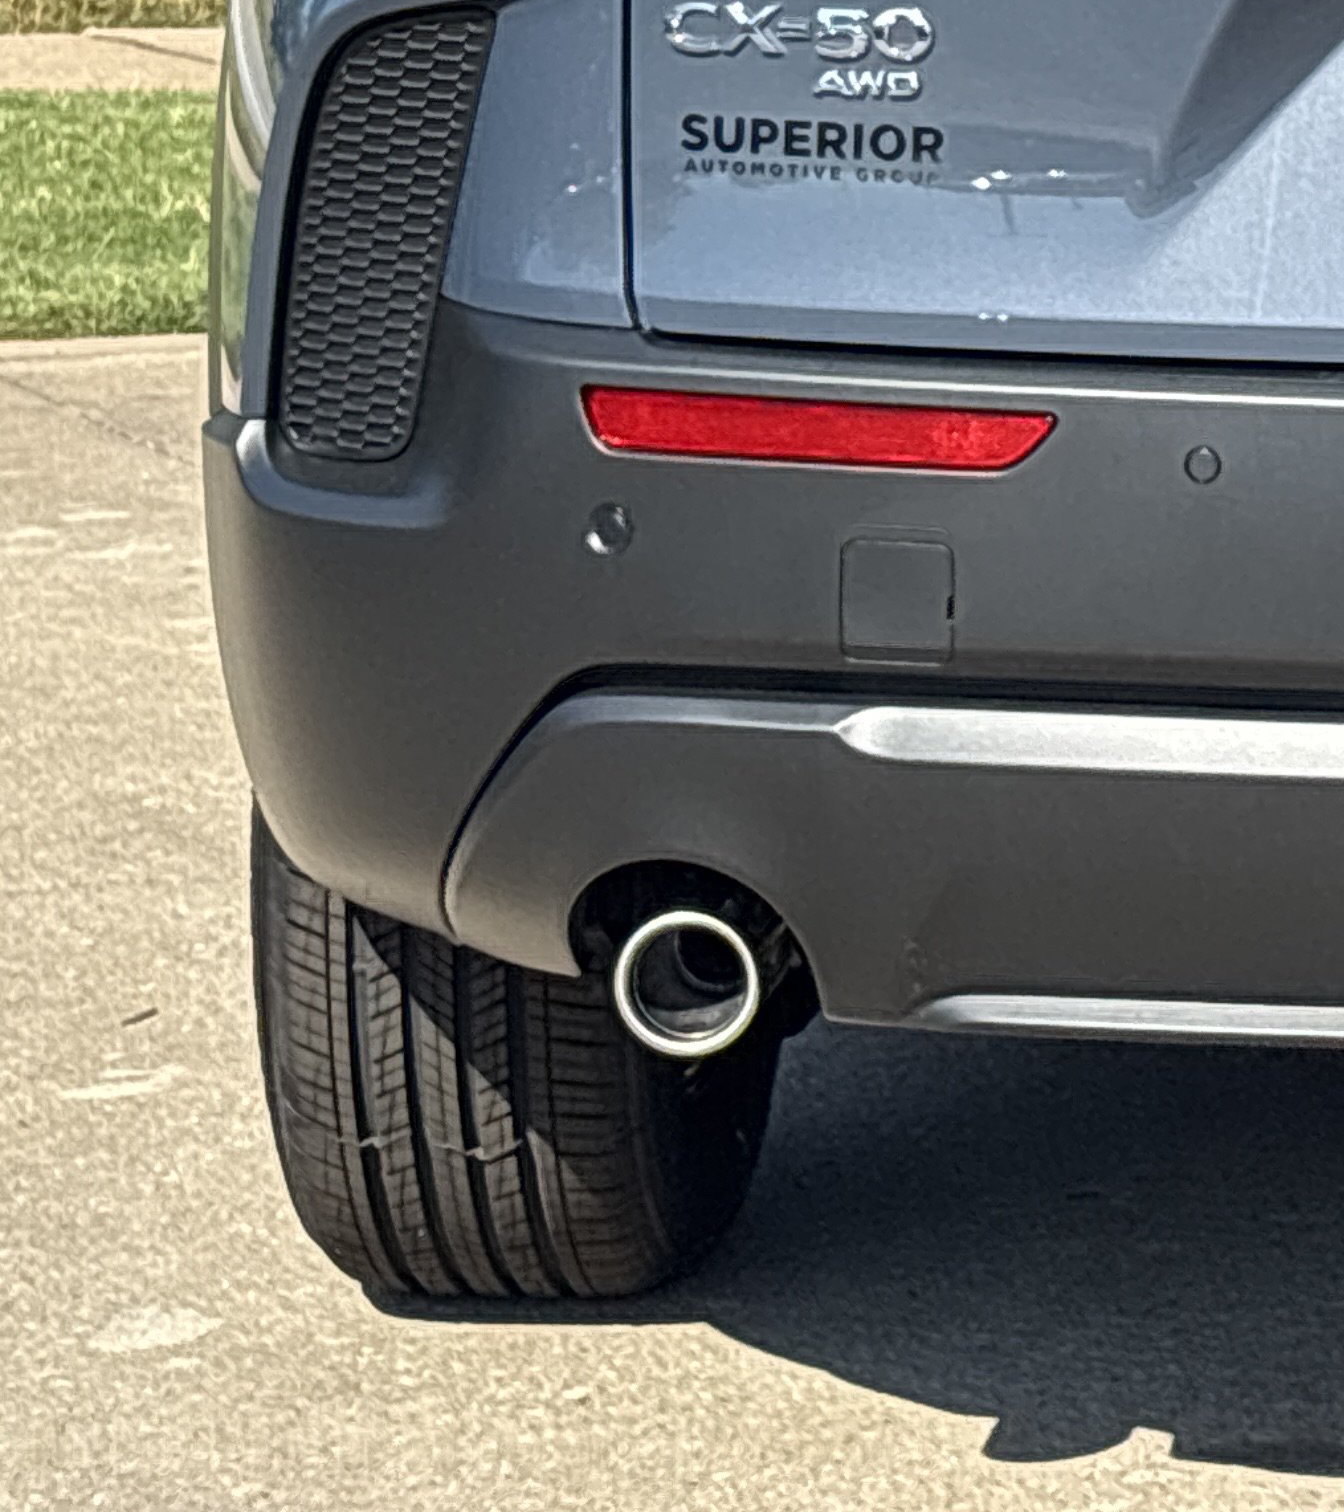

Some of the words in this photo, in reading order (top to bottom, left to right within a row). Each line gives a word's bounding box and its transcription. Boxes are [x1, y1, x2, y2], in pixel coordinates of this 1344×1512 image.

[664, 1, 934, 62] CX-50
[814, 68, 920, 98] AWD
[680, 113, 944, 163] SUPERIOR
[684, 158, 841, 181] AUTOMOTIVE
[856, 167, 941, 185] GROUP
